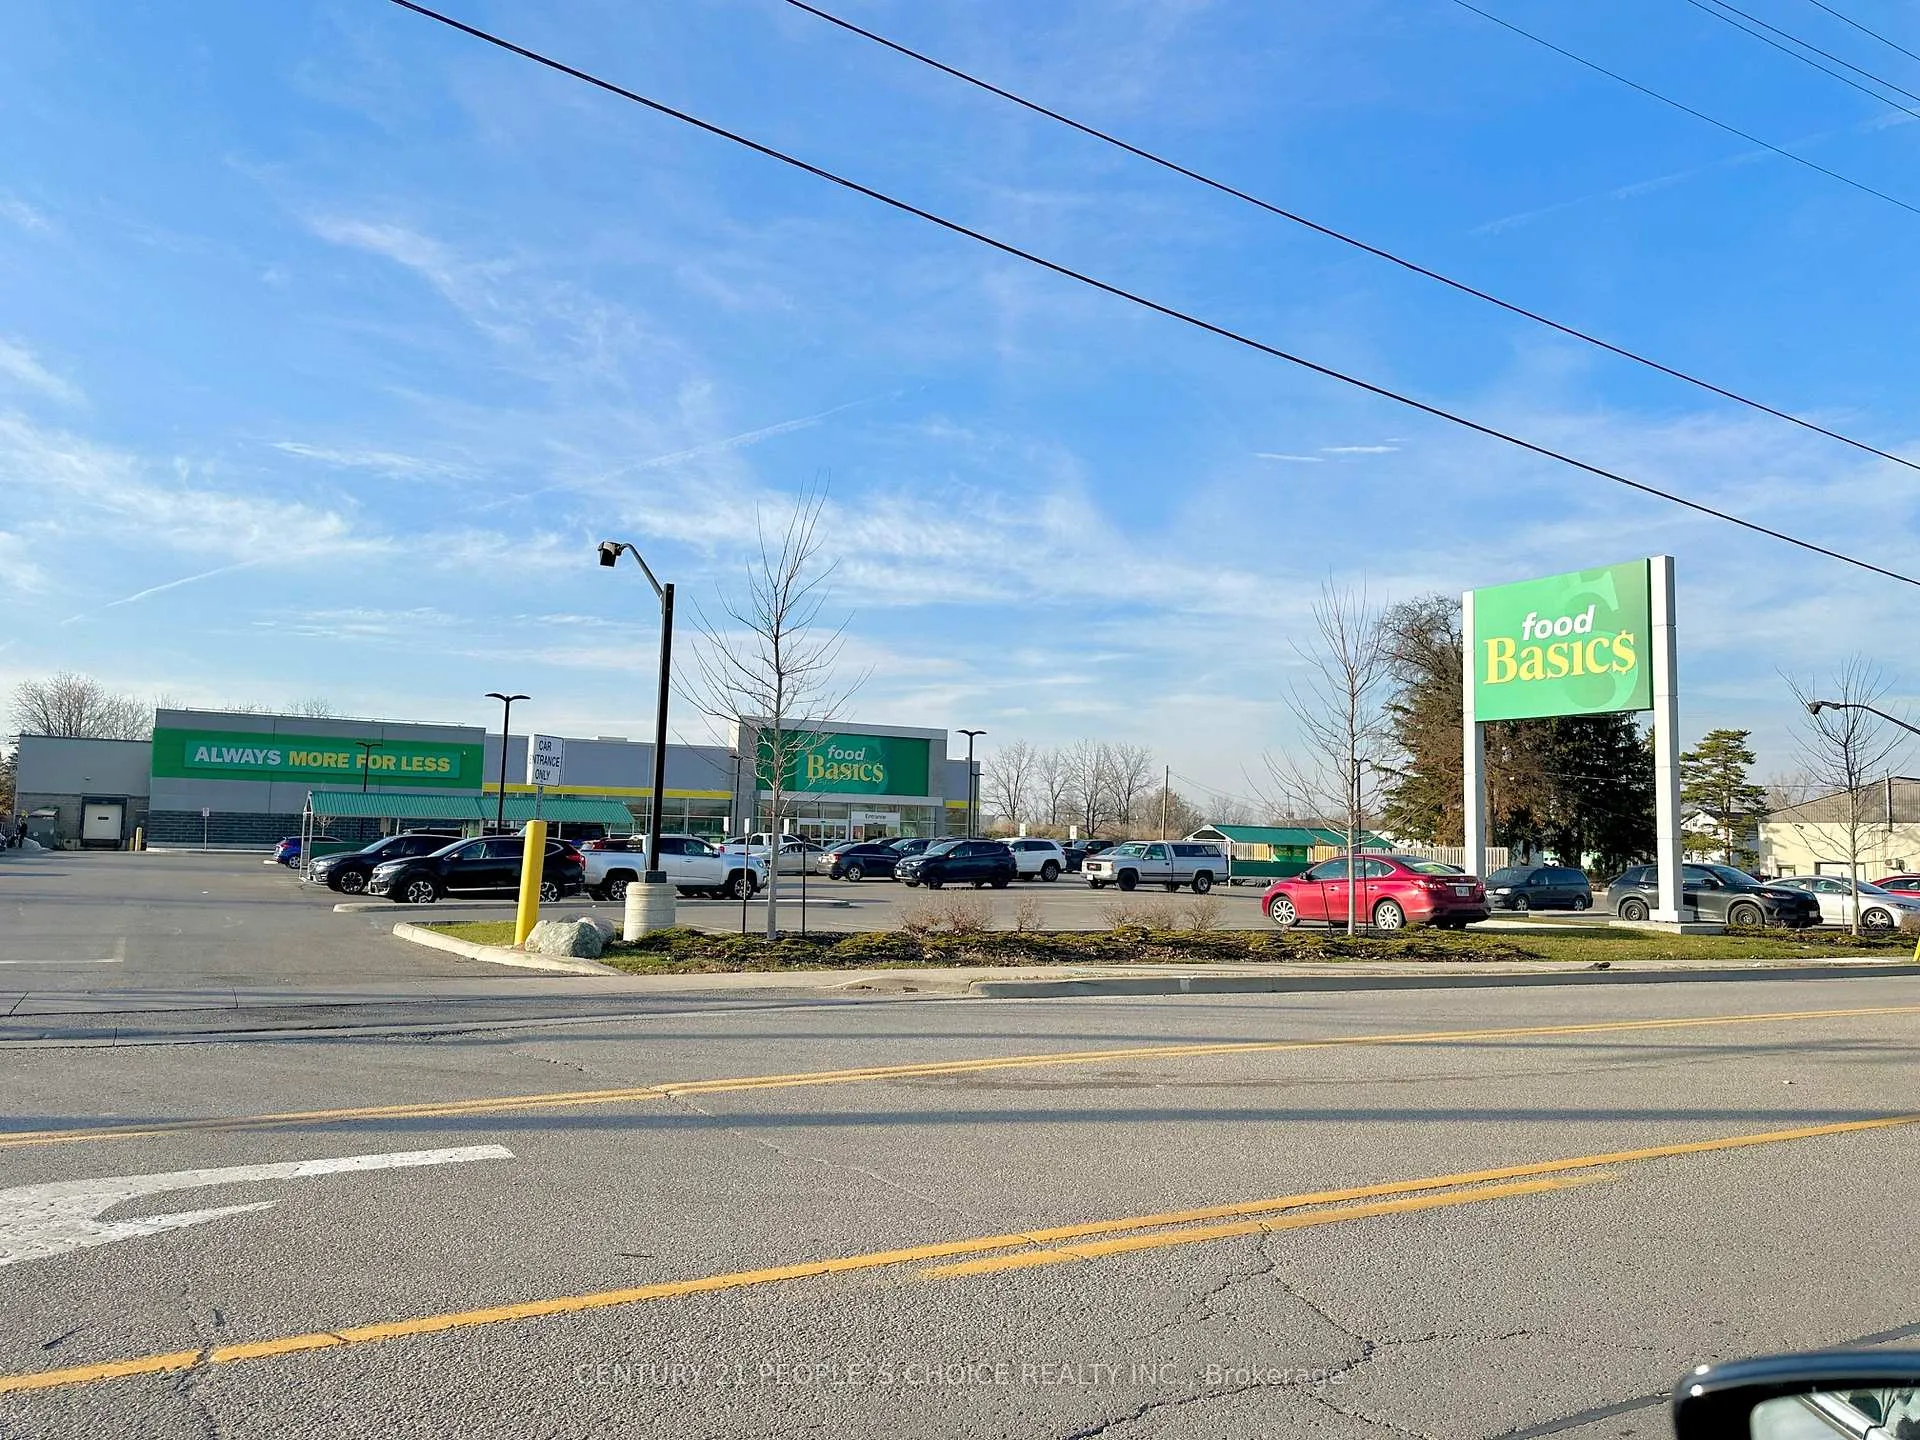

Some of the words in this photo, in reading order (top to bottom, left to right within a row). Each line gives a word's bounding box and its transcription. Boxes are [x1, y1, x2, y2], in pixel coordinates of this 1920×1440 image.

[1522, 604, 1596, 640] food
[538, 740, 552, 751] CAR
[827, 744, 866, 760] food
[194, 746, 281, 765] ALWAYS
[288, 750, 350, 768] MORE
[356, 753, 396, 770] FOR
[401, 756, 450, 772] LESS
[529, 754, 560, 768] NTRANCE
[535, 769, 550, 780] ONLY
